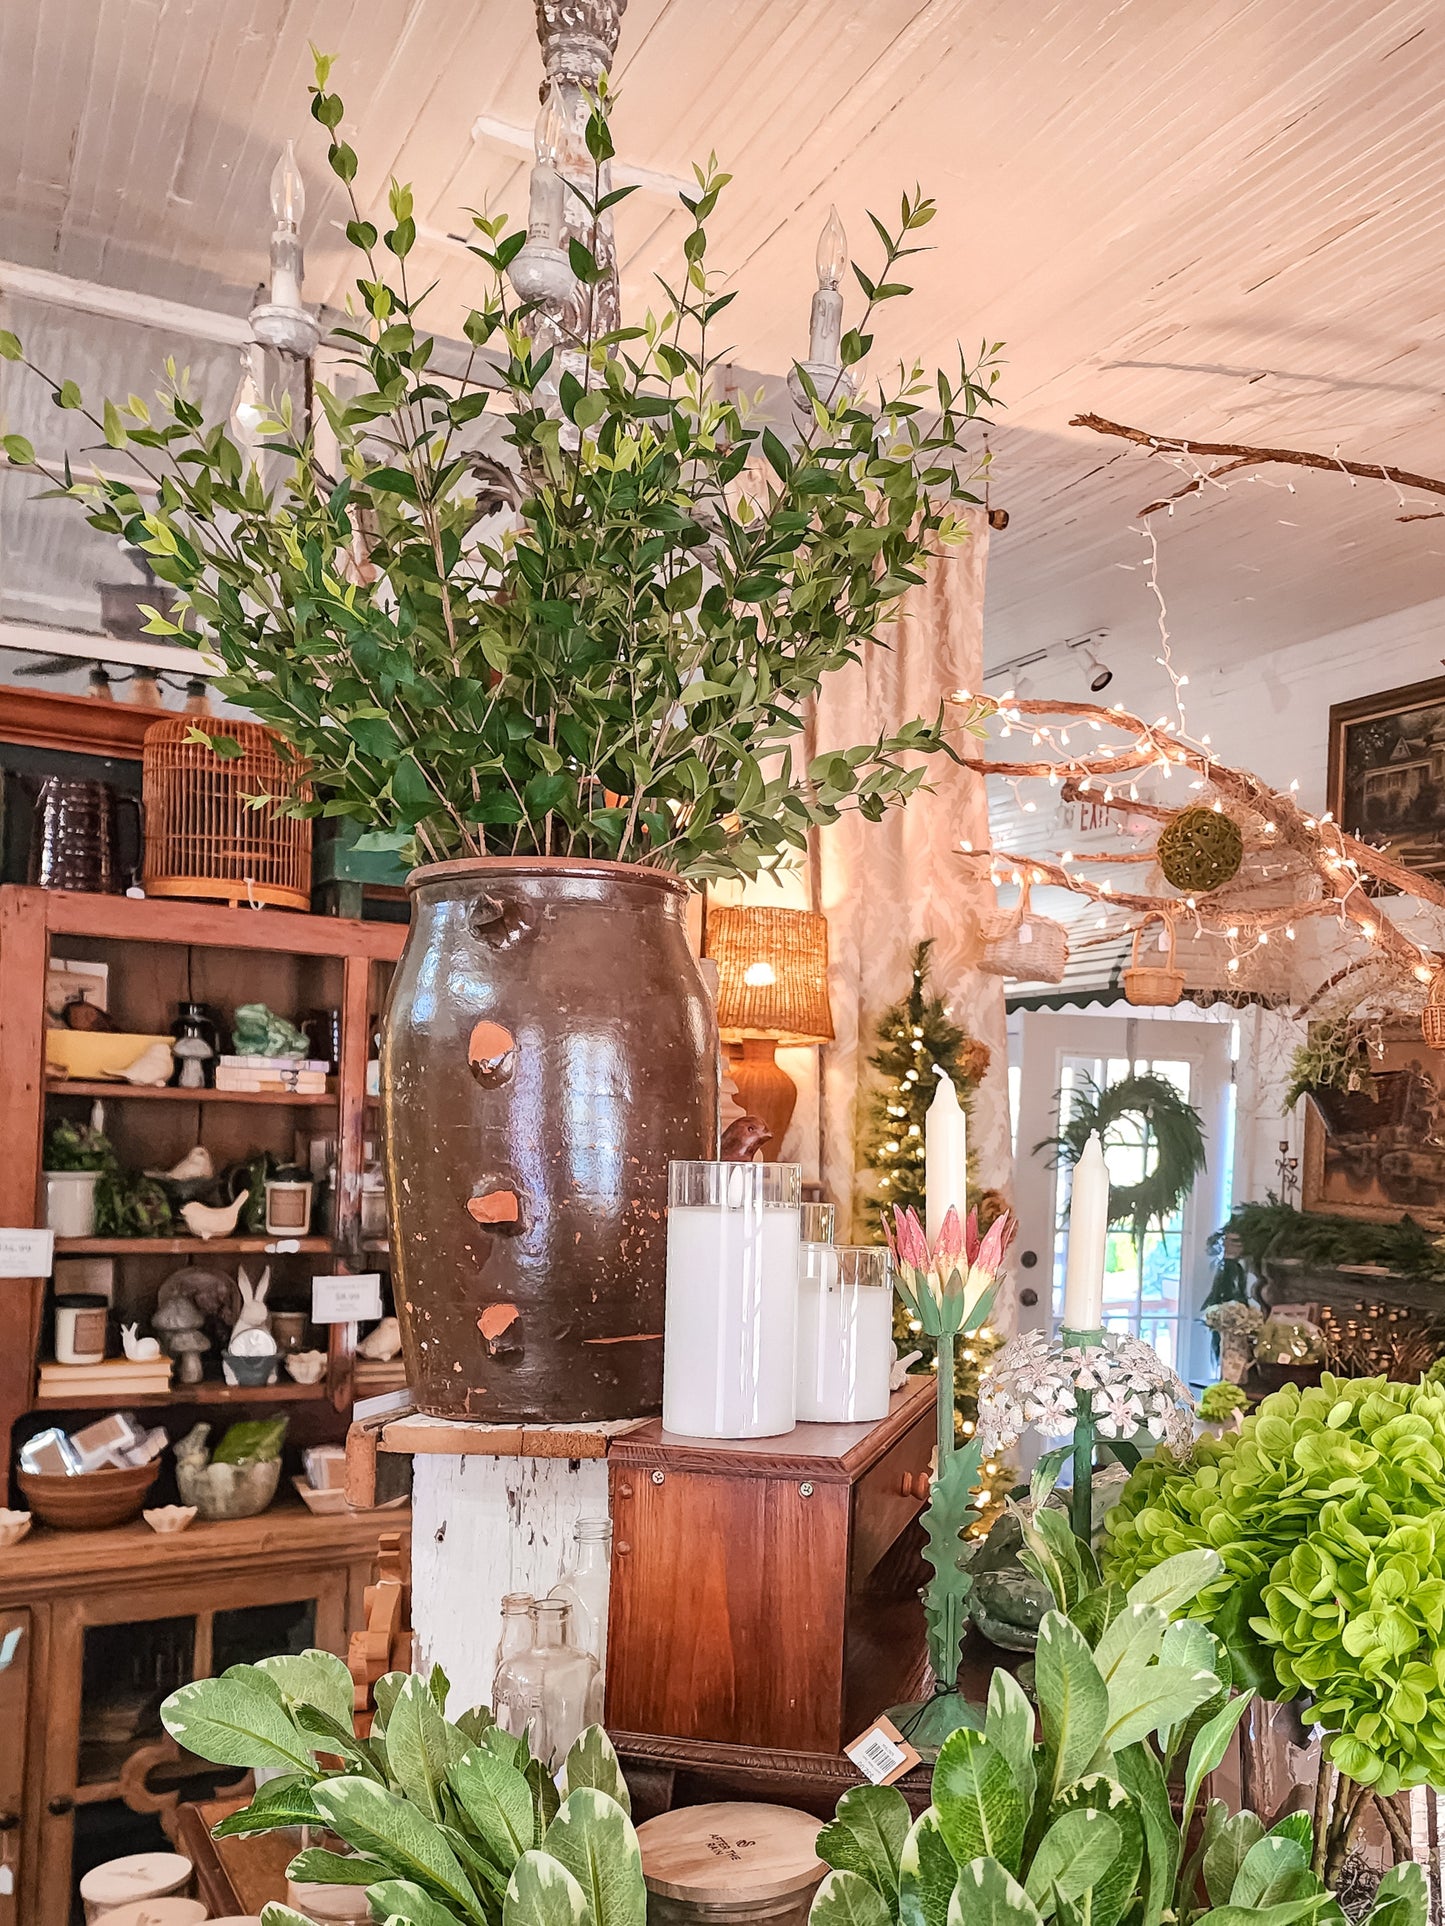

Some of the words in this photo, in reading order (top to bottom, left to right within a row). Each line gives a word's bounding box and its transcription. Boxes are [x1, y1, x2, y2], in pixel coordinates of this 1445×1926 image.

[705, 1842, 725, 1856] RAIN
[708, 1833, 731, 1850] AFTER
[725, 1849, 742, 1861] THE
